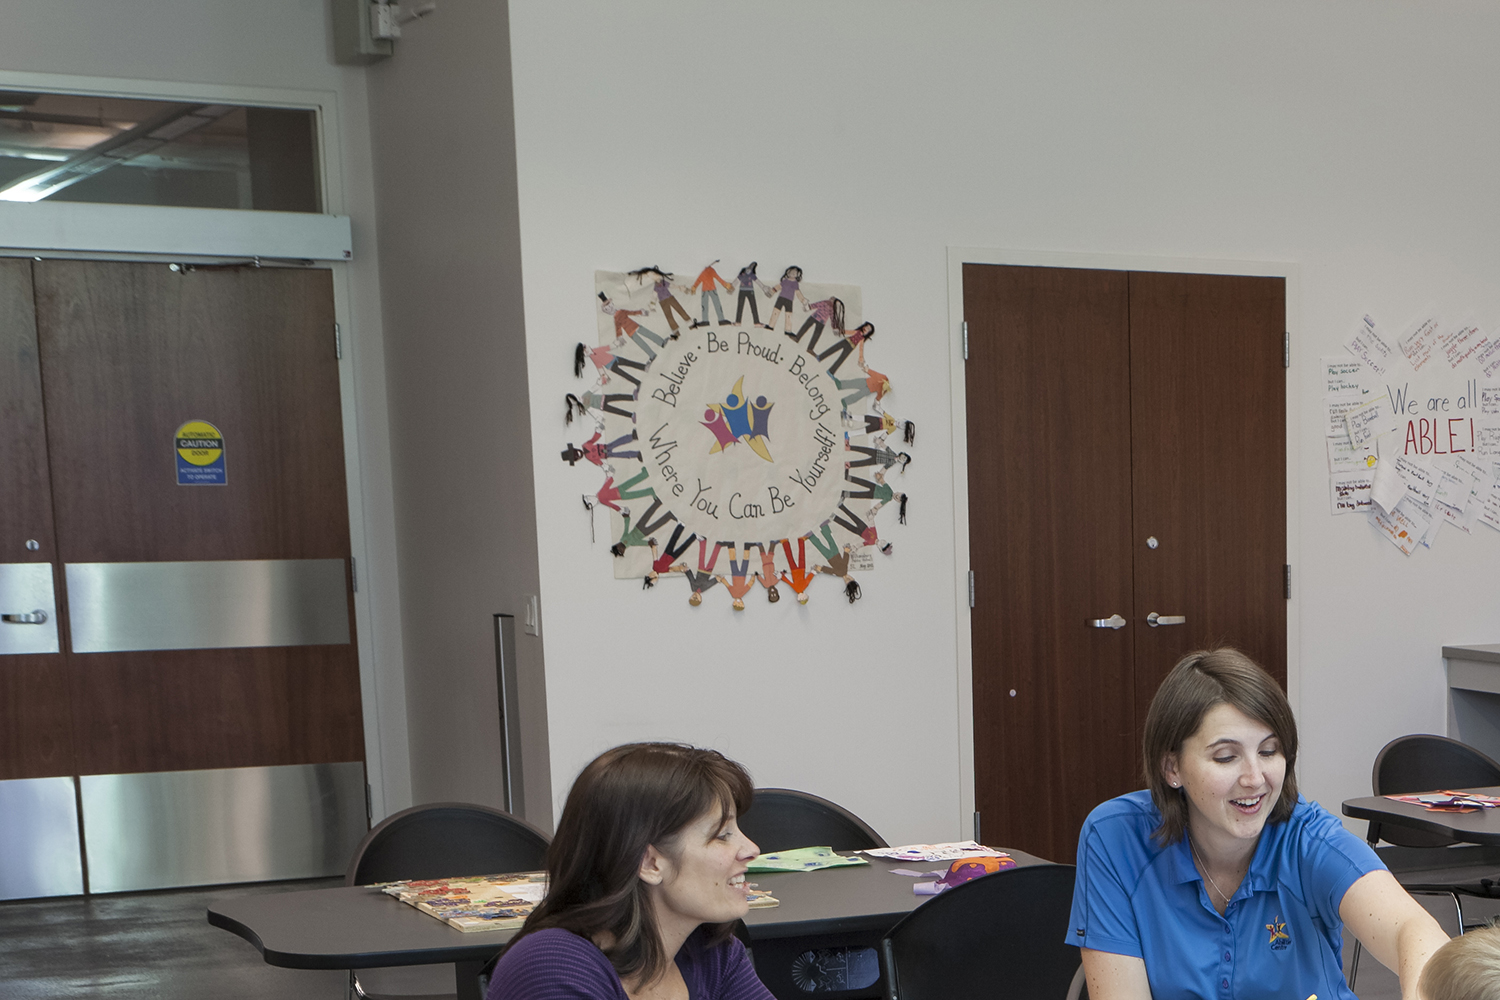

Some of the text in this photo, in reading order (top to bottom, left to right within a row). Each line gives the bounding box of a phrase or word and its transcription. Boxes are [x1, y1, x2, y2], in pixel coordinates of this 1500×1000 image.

[652, 351, 698, 407] Believe
[707, 332, 729, 353] Be
[789, 355, 830, 421] Belong
[1386, 379, 1477, 415] We are all
[1404, 418, 1475, 455] ABLE!
[649, 423, 836, 519] Where You Can Be Yourself!
